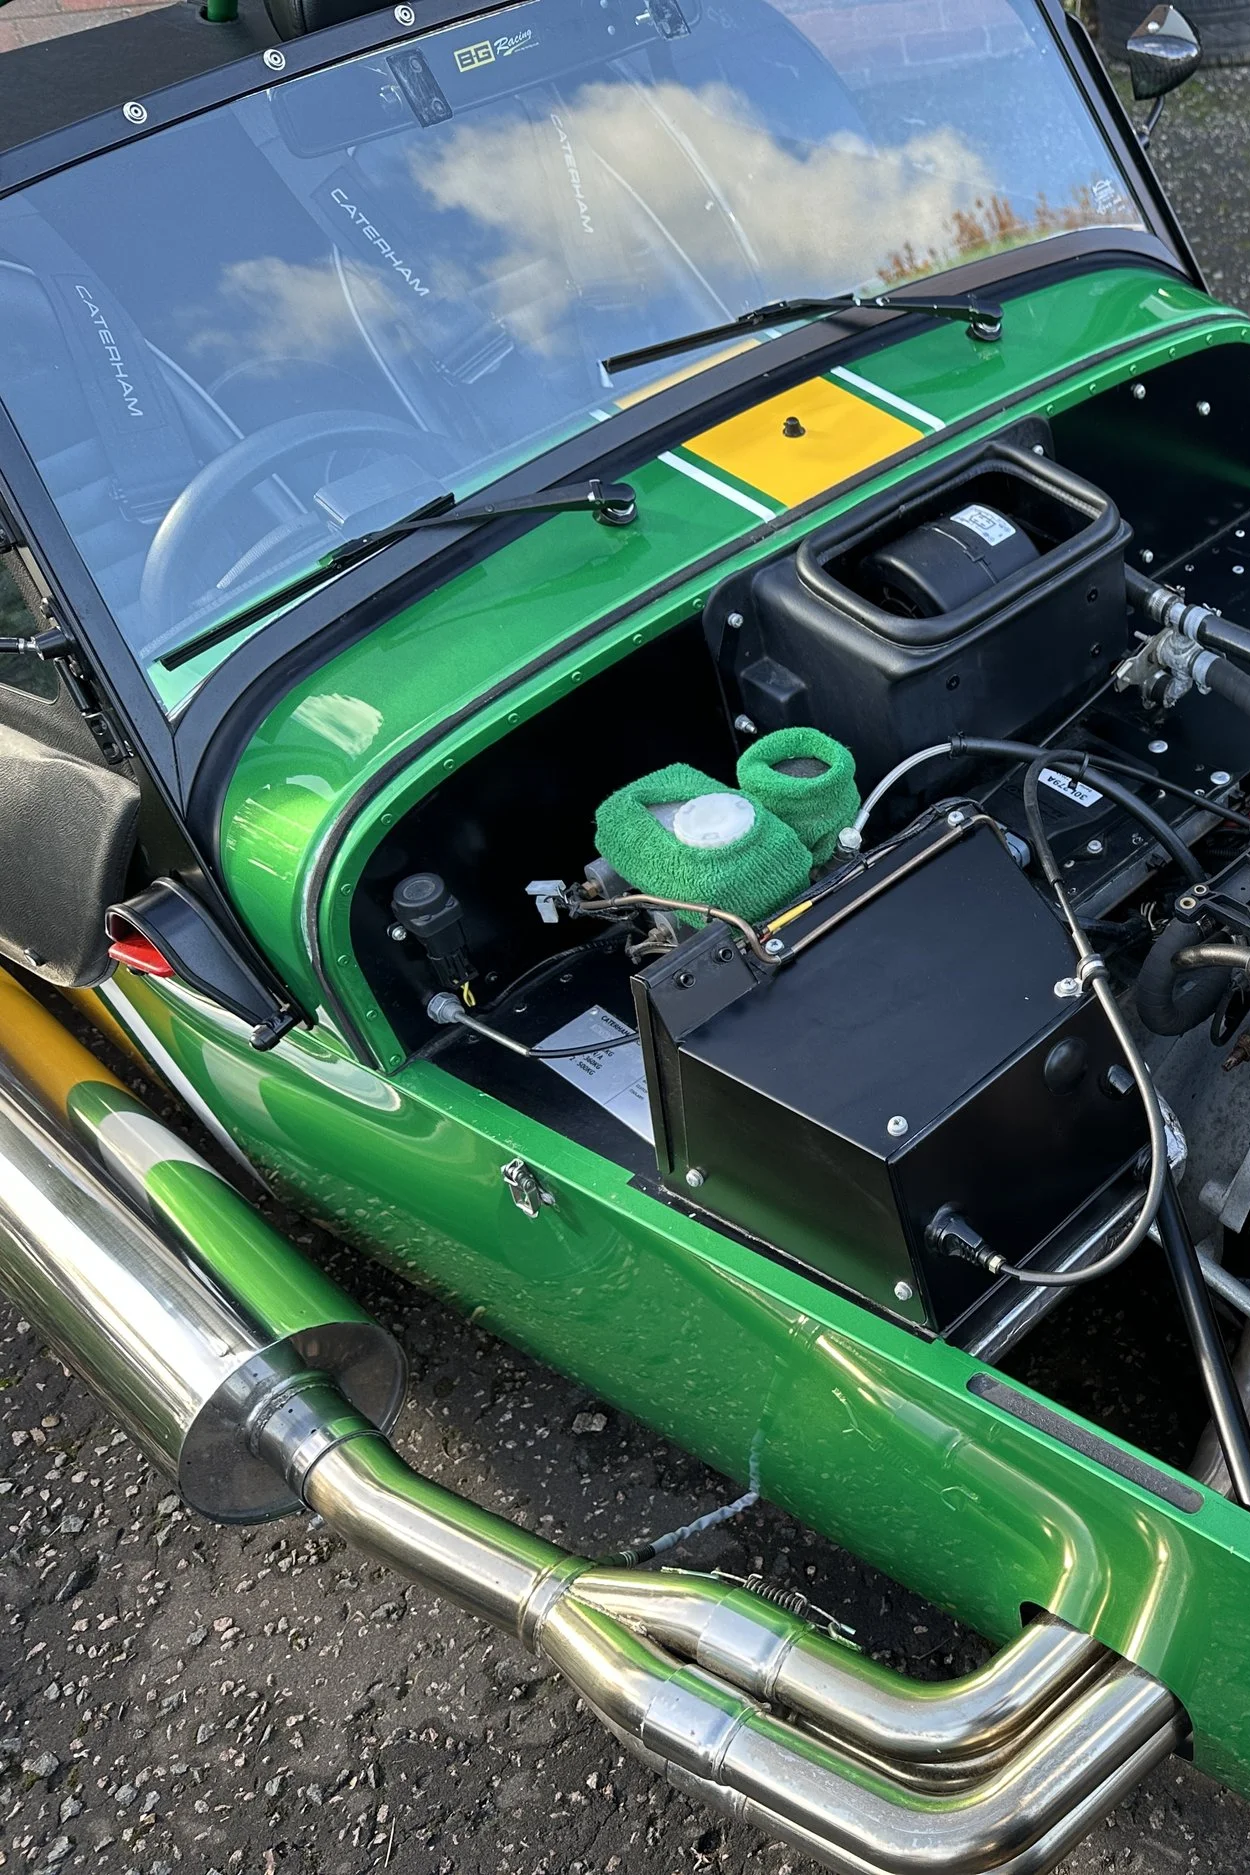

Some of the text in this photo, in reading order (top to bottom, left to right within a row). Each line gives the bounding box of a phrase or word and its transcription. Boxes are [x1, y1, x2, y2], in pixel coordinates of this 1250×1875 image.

[494, 29, 531, 55] Racing
[550, 113, 594, 233] CATERHAM
[330, 187, 430, 297] CATERHAM
[75, 284, 144, 417] CATERHAM
